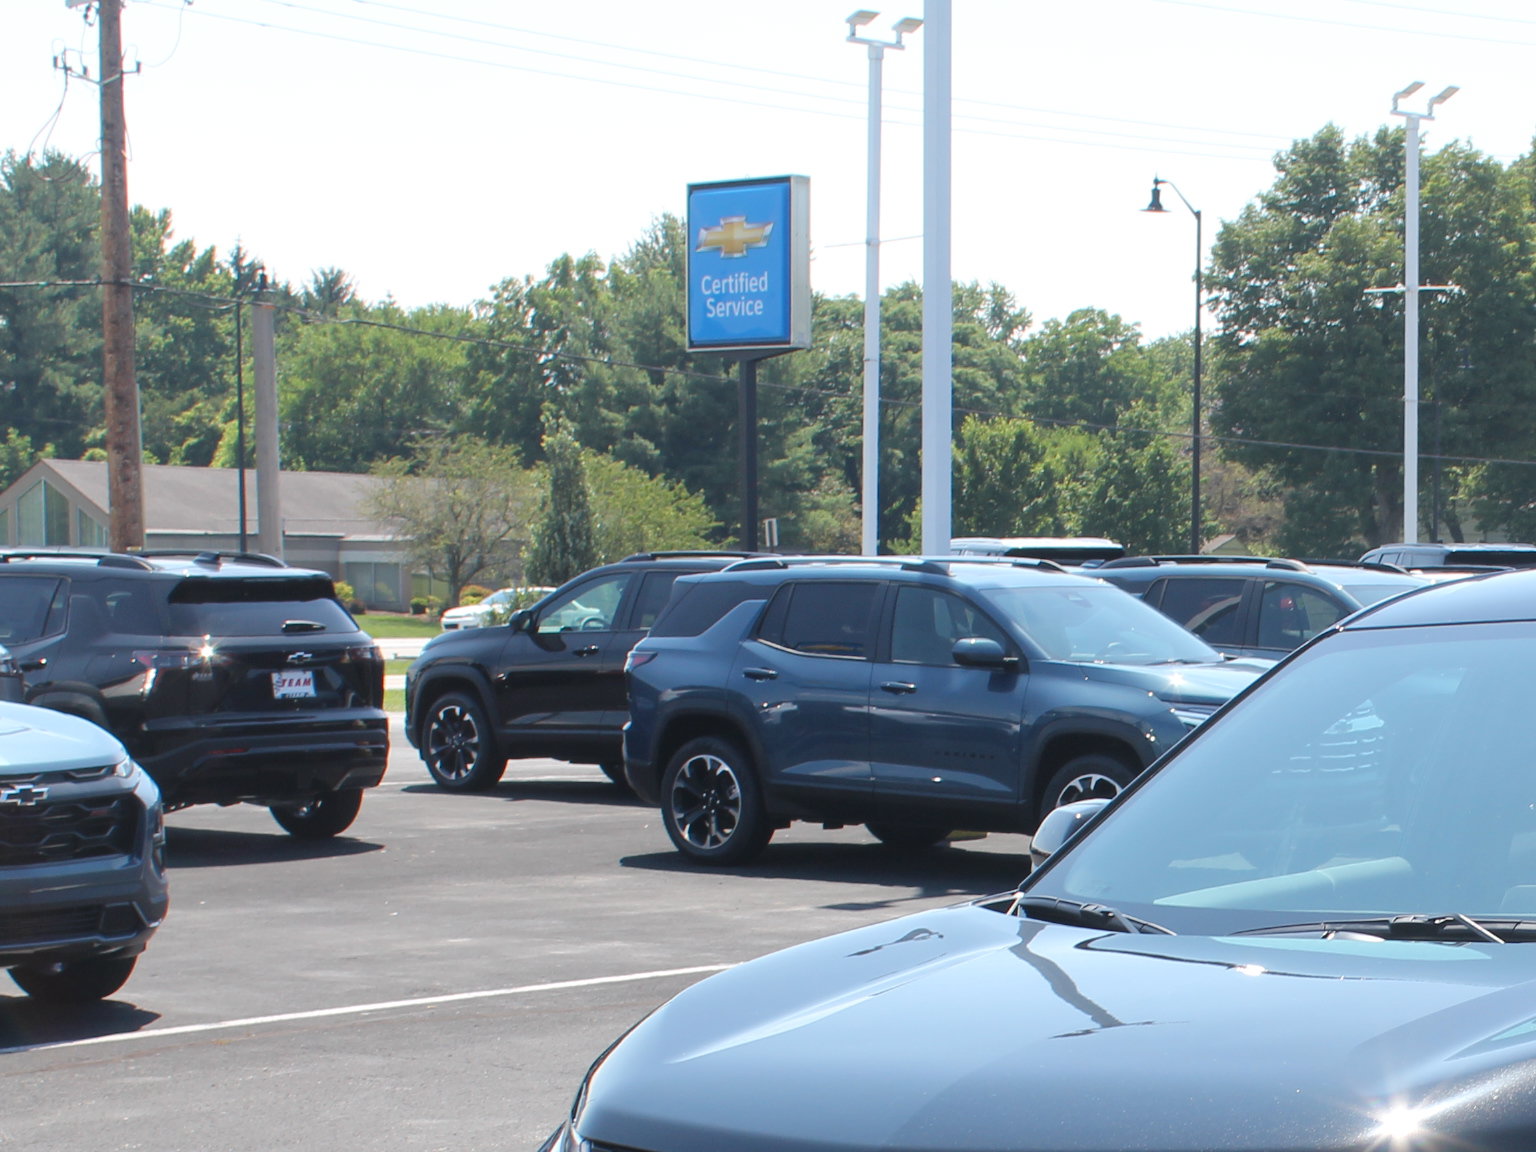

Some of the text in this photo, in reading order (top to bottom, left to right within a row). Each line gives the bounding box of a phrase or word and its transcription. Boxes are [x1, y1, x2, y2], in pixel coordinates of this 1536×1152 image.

[701, 271, 769, 295] Certified
[706, 296, 764, 318] Service
[281, 678, 312, 688] TEAM
